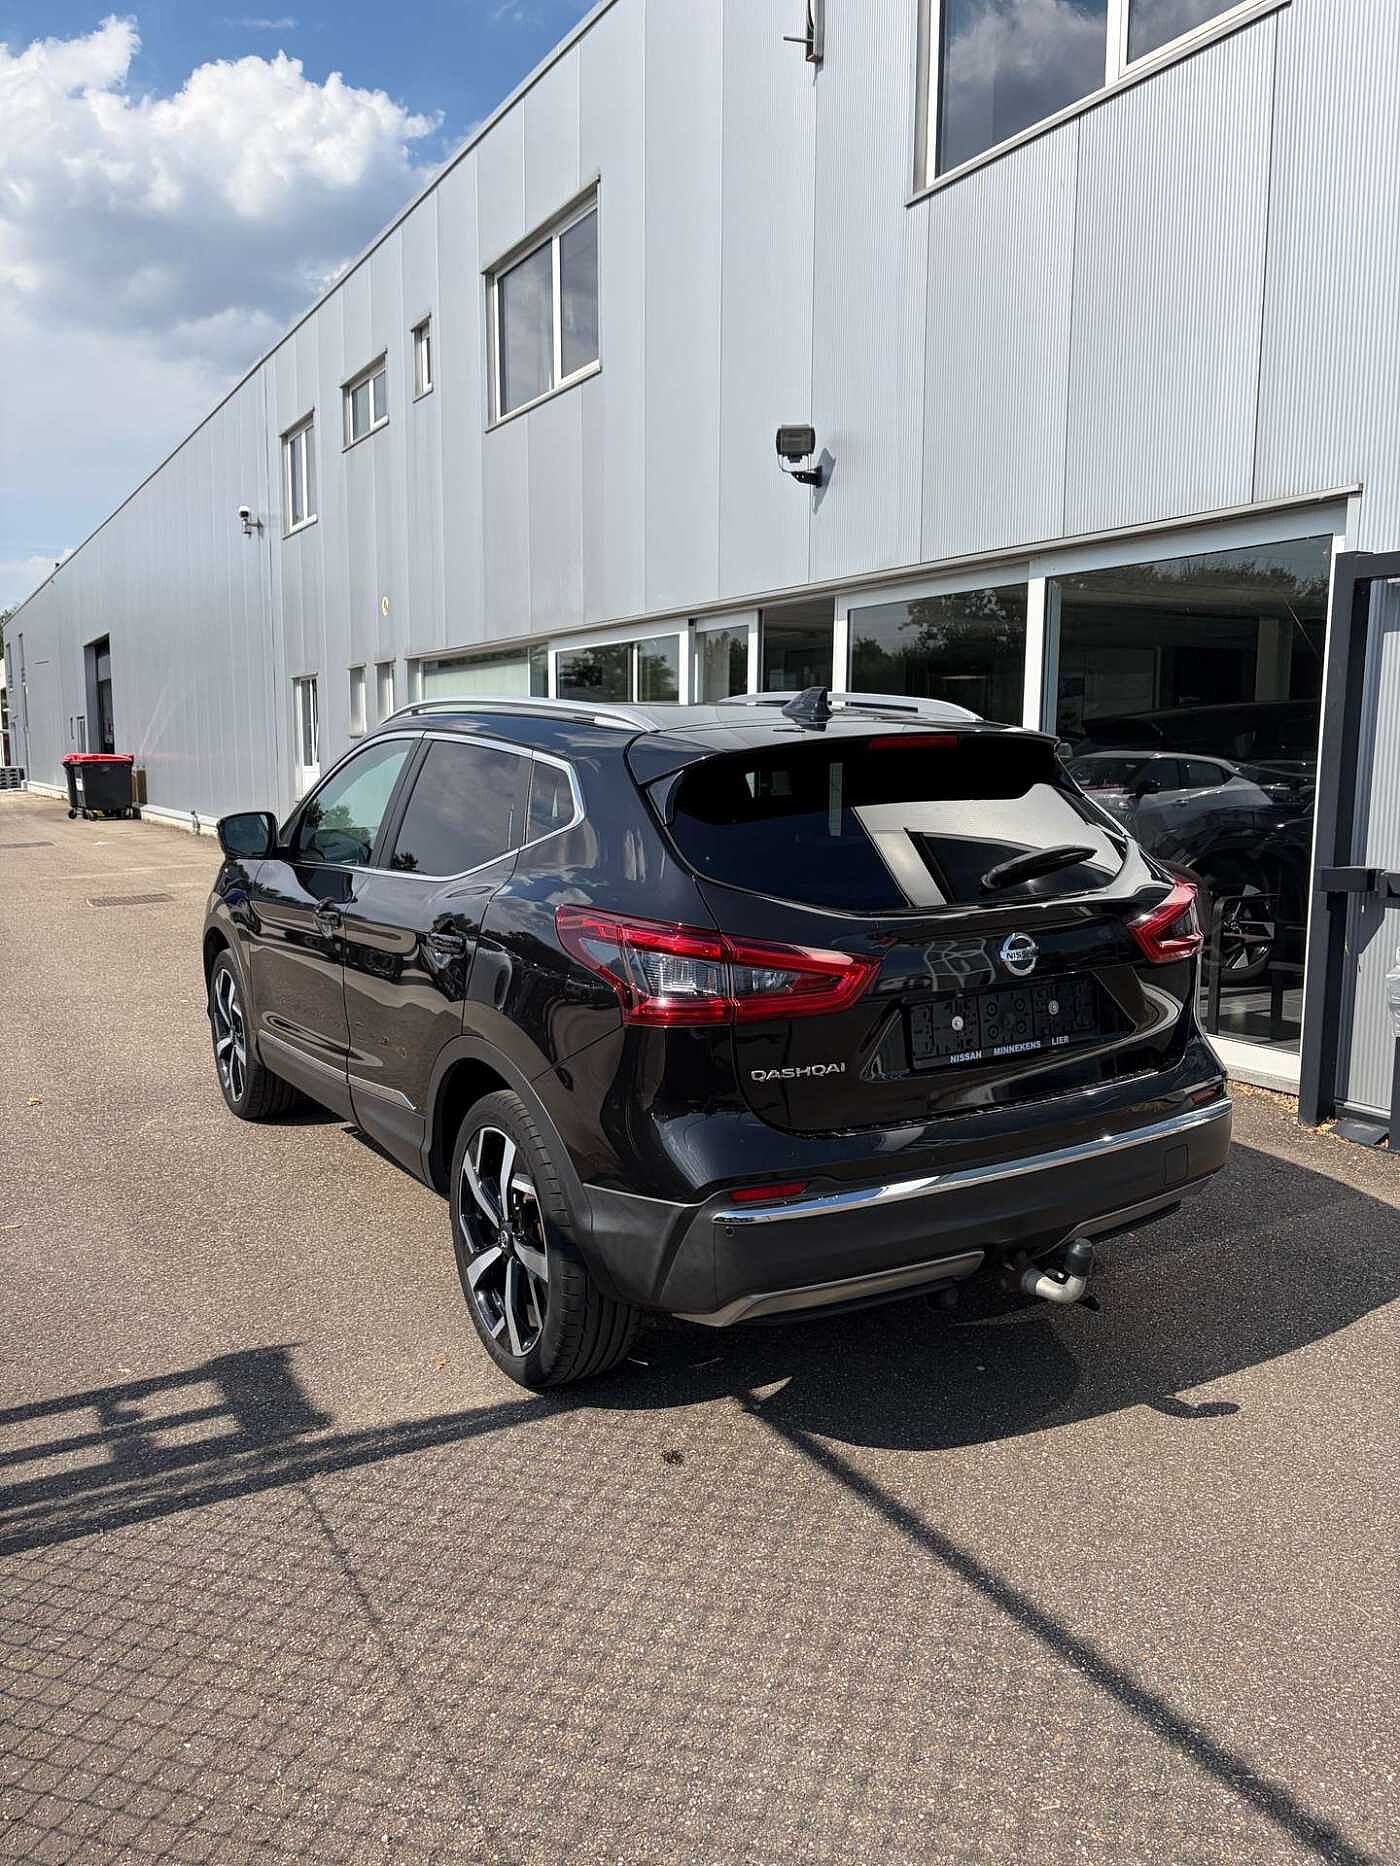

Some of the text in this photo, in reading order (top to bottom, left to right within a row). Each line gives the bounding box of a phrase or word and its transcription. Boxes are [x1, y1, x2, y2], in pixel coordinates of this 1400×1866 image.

[950, 1036, 1069, 1063] NISSAN MINNEKENS LIER
[751, 1062, 845, 1082] QASHQAI
